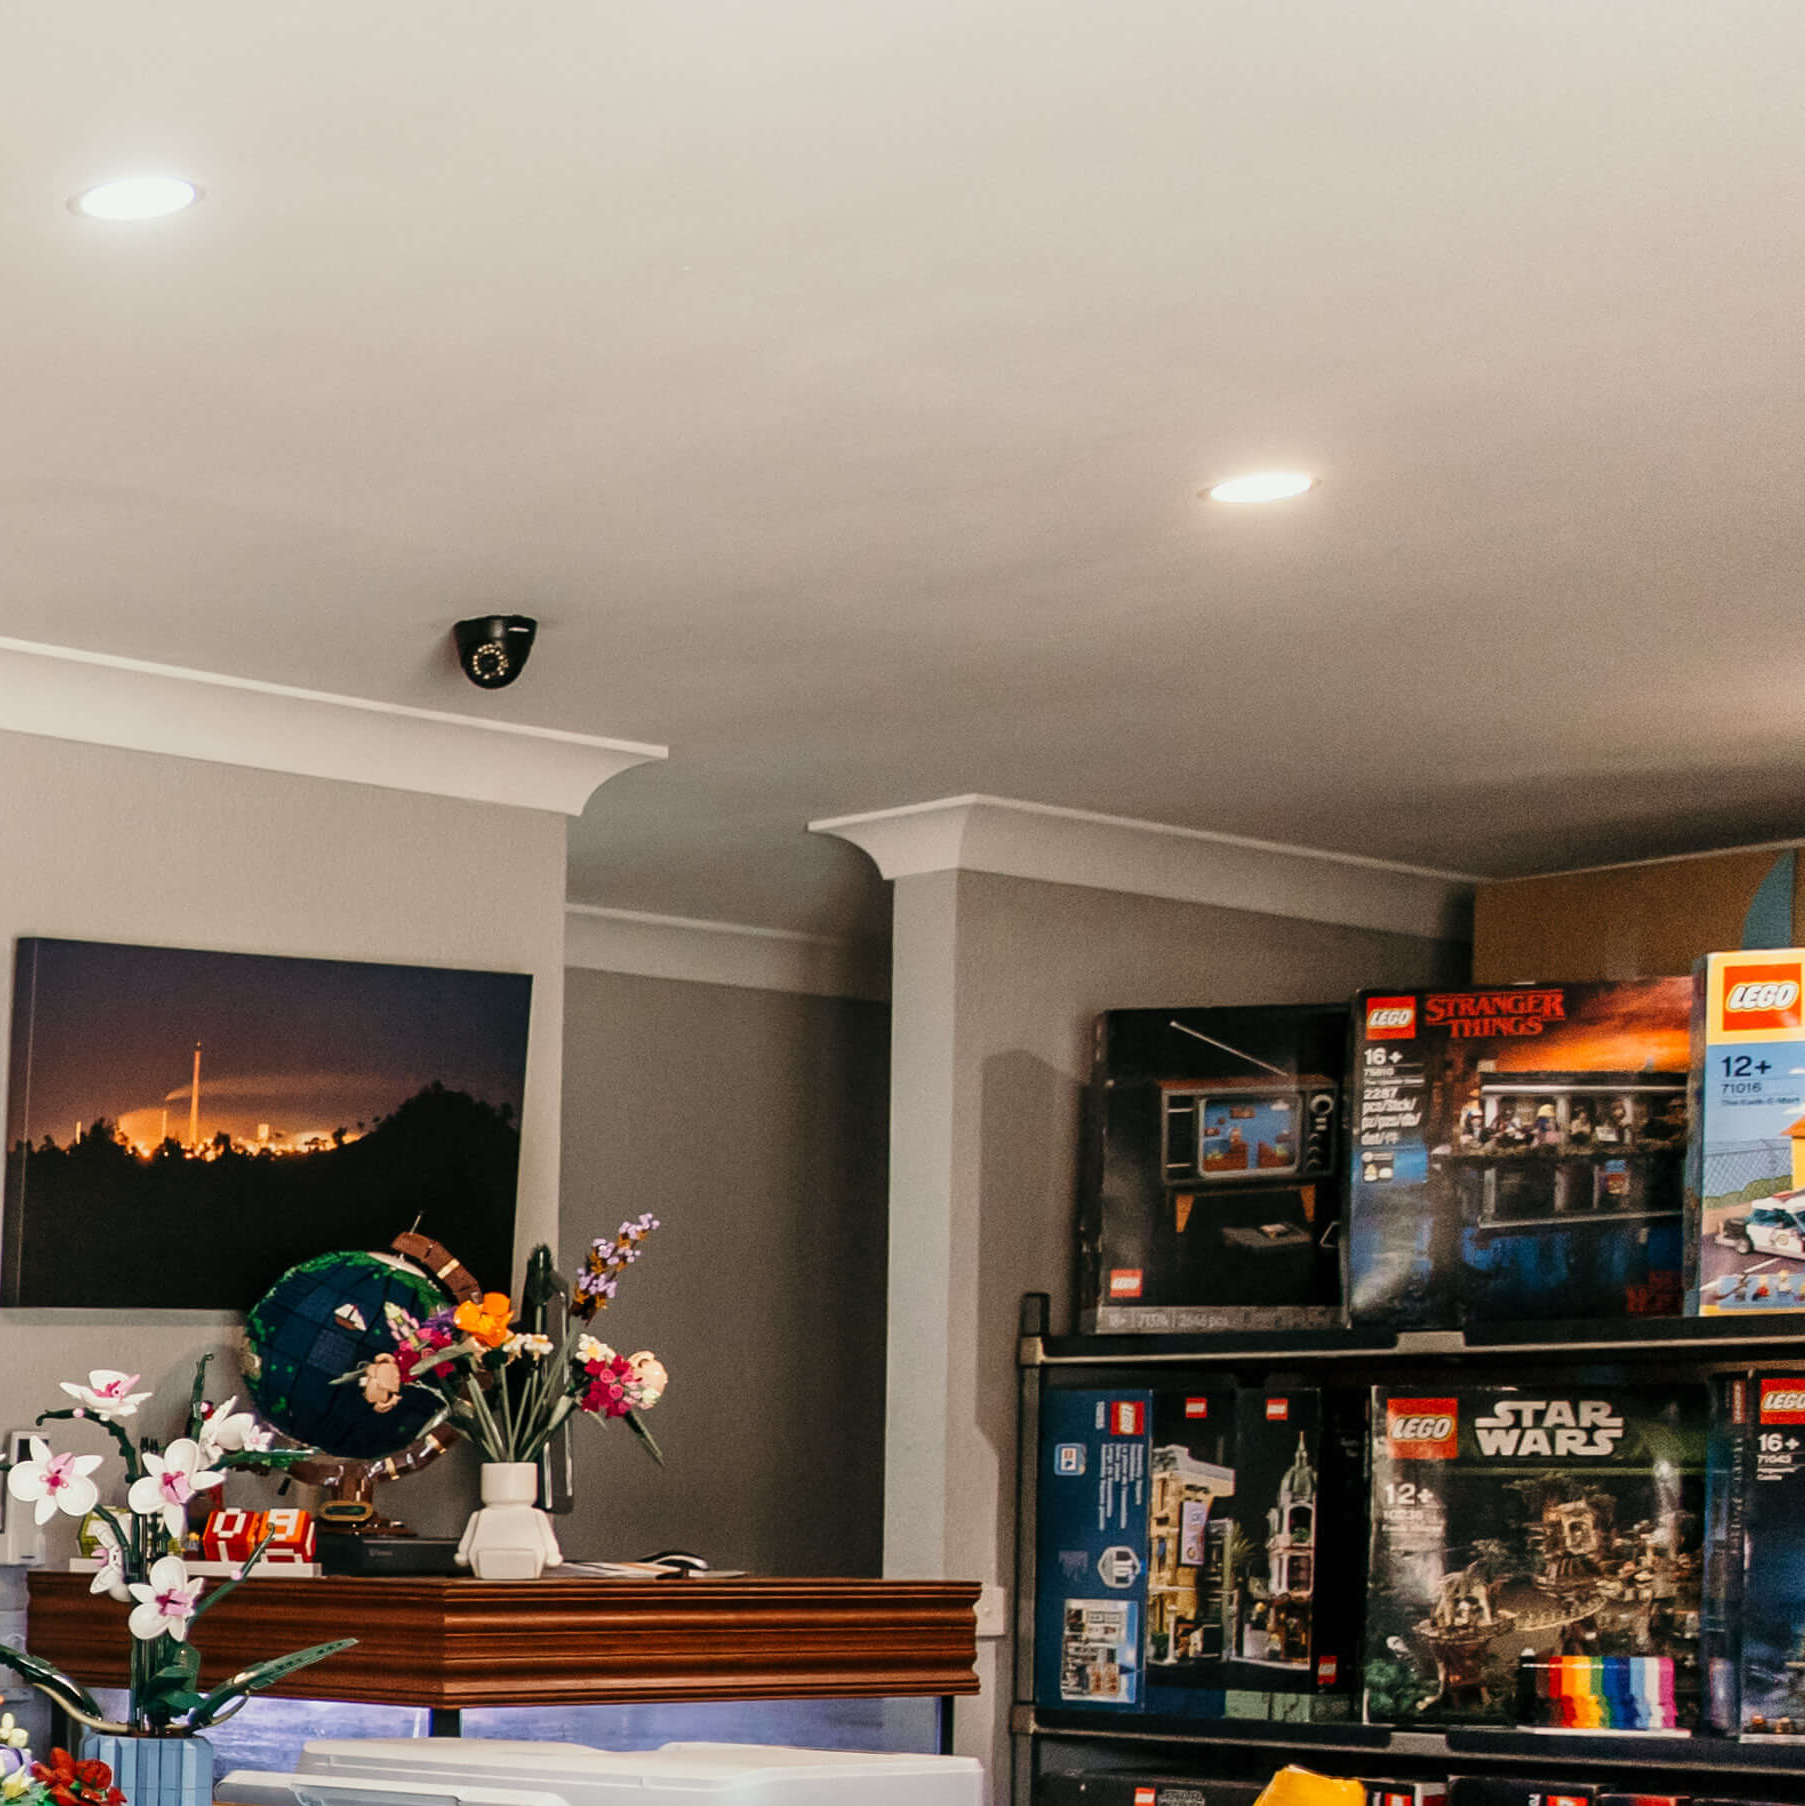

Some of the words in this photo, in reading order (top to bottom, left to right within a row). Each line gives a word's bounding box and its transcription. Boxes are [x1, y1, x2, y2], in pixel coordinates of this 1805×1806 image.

[1425, 987, 1565, 1026] STRANGER
[1727, 983, 1799, 1012] LEGO
[1369, 1010, 1413, 1026] LEGO
[1447, 1016, 1544, 1038] THINGS
[1722, 1055, 1772, 1078] 12+
[1722, 1082, 1762, 1096] 71016
[1475, 1400, 1623, 1428] STAR
[1390, 1416, 1454, 1440] LEGO
[1475, 1428, 1623, 1456] WARS
[1758, 1432, 1801, 1452] 16+
[1384, 1482, 1435, 1506] 12+
